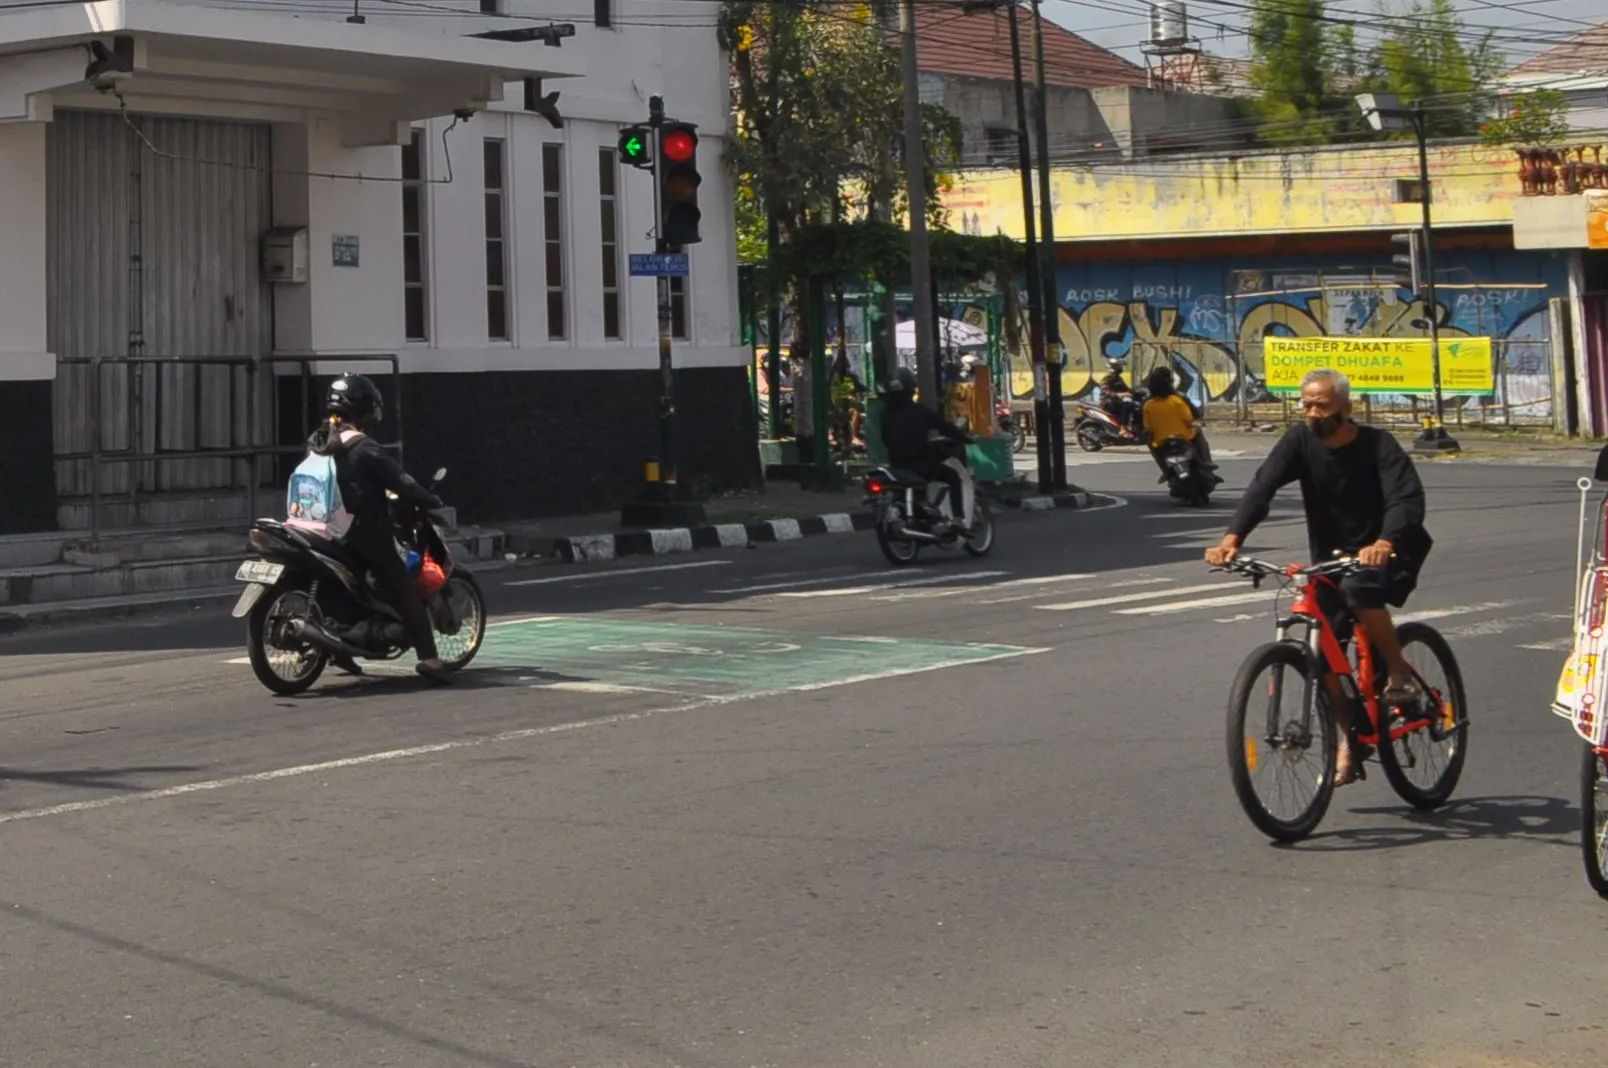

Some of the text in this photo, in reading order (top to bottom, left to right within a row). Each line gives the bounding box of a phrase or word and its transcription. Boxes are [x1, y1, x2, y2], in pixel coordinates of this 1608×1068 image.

[1270, 341, 1415, 353] TRANSFER ZAKAT KE
[1272, 355, 1403, 367] DOMPET DHUAFA
[1272, 370, 1298, 381] AJA
